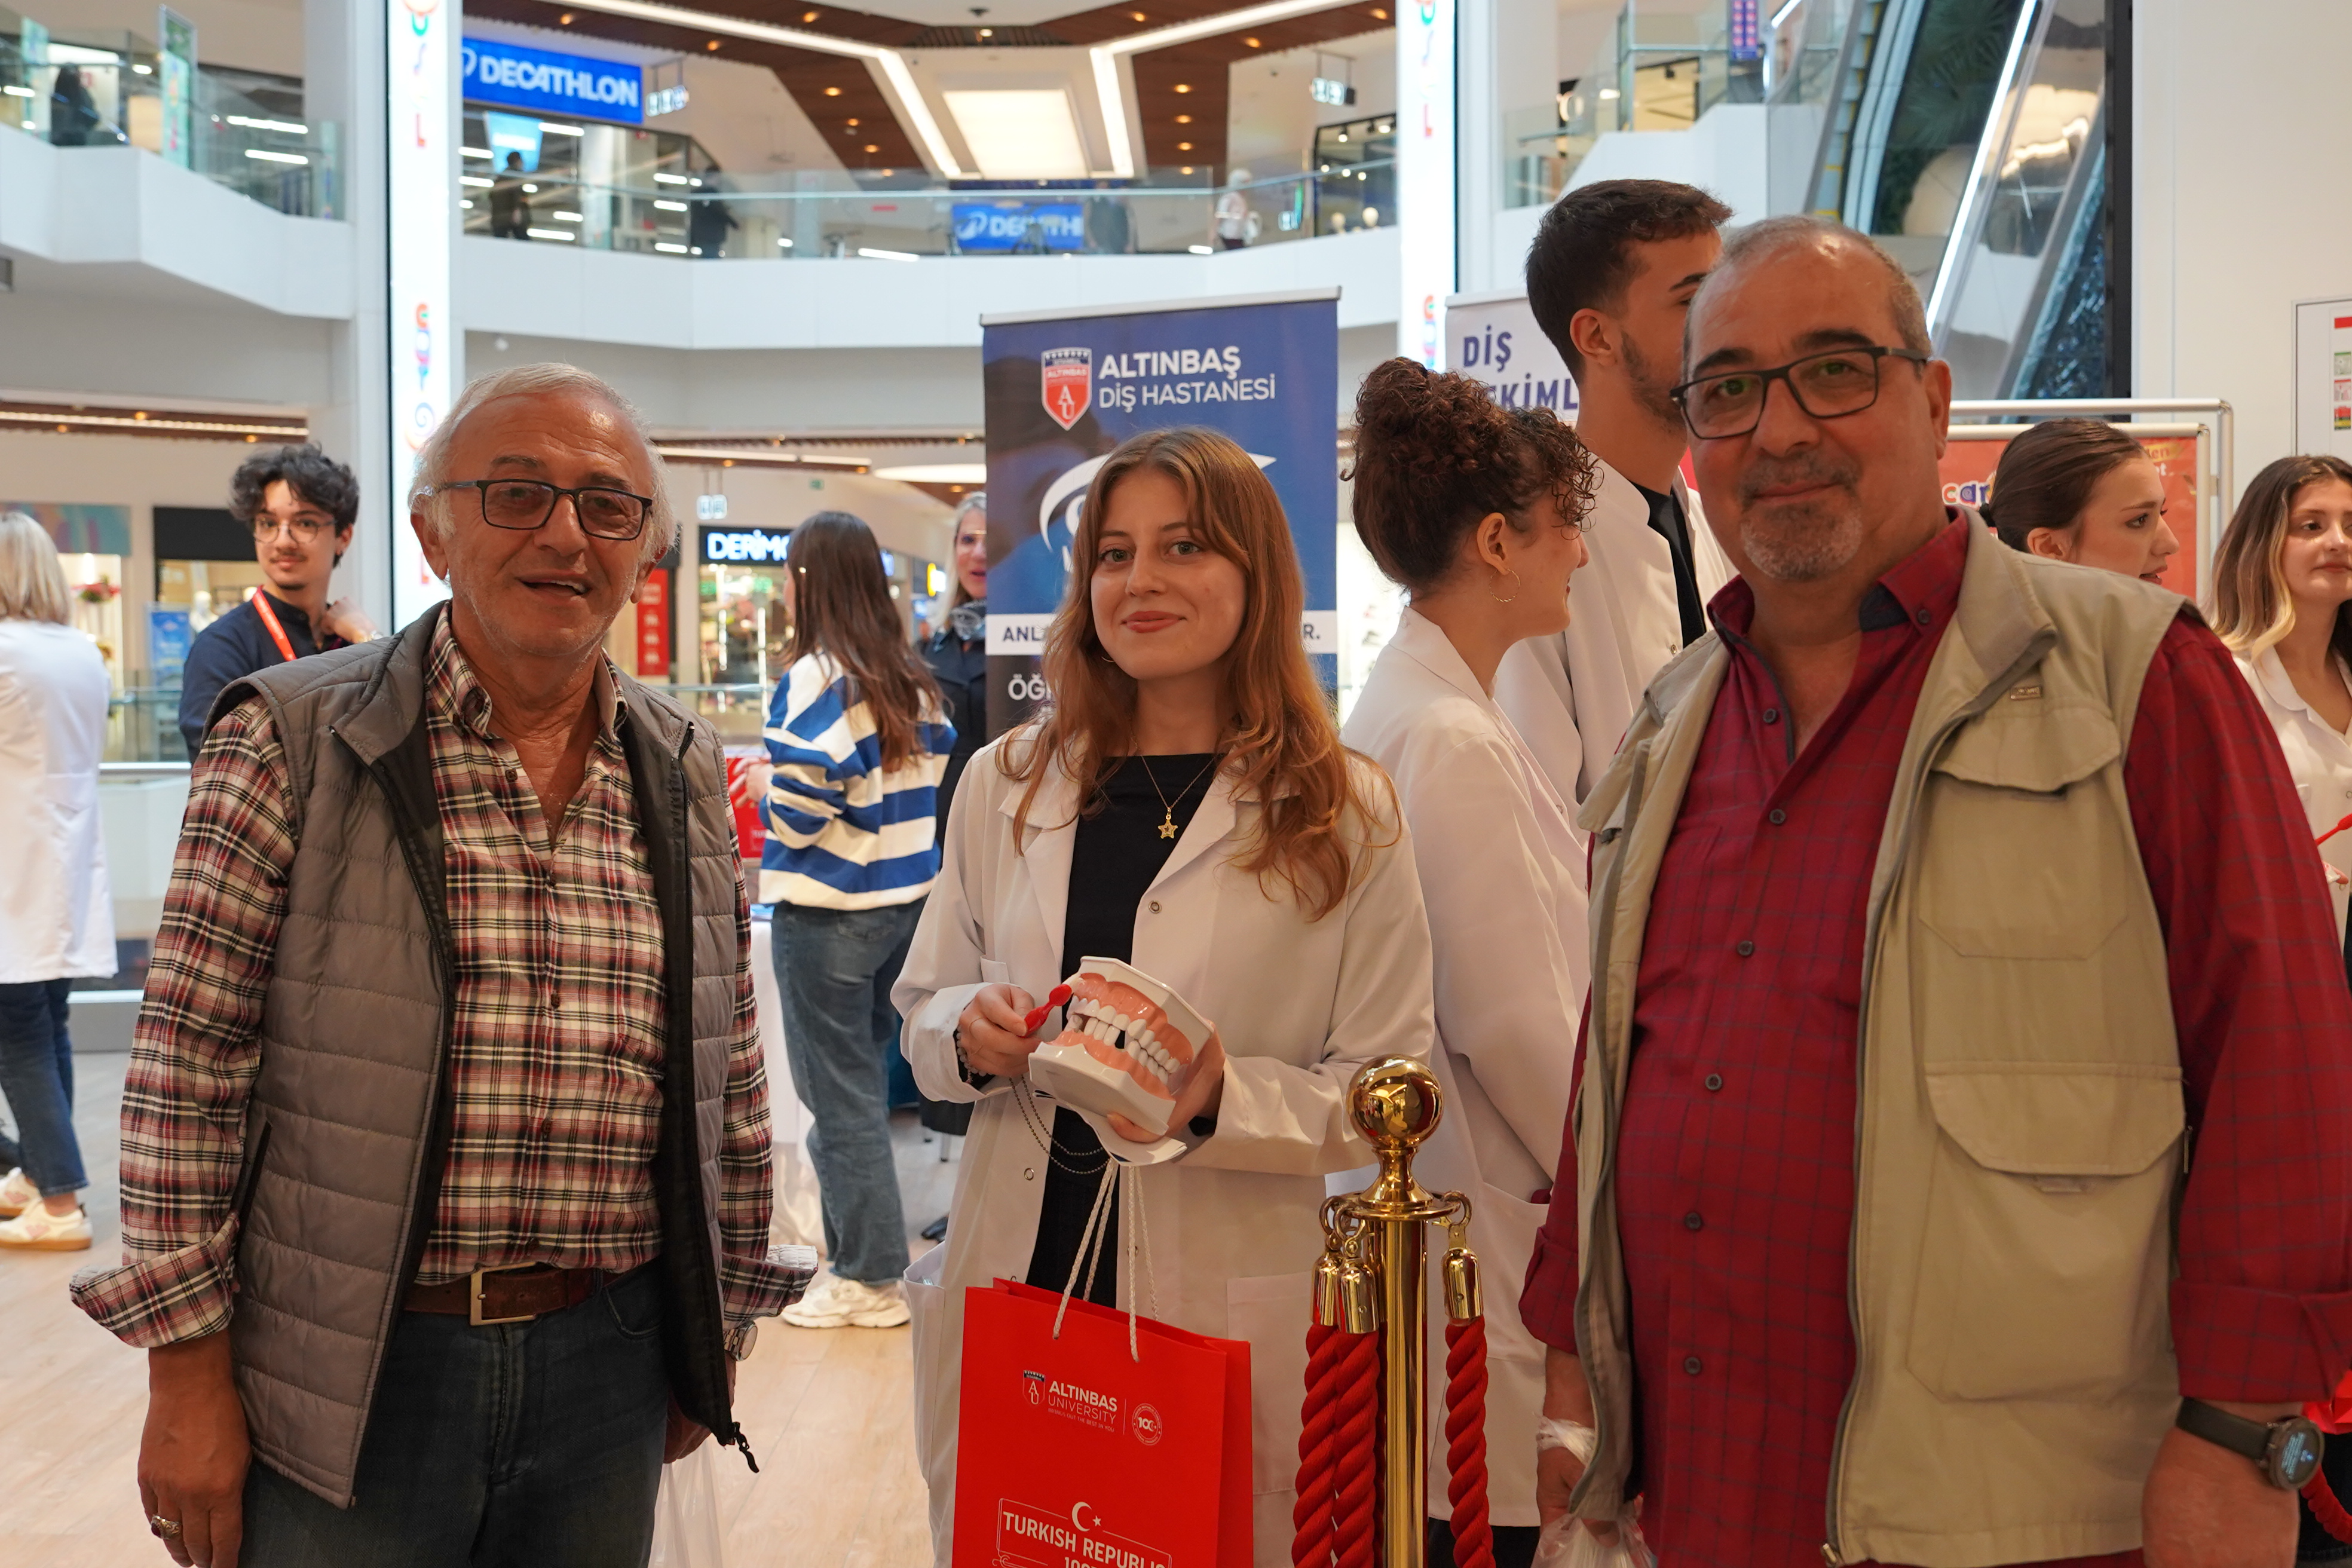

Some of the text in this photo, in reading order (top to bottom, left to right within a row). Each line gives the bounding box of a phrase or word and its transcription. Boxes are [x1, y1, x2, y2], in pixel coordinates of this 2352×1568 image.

[480, 55, 639, 108] DECATHLON
[1098, 345, 1242, 380] ALTINBAŞ
[1463, 324, 1512, 372] DİŞ
[1099, 373, 1276, 413] DİŞ HASTANESİ
[1488, 372, 1578, 411] KİML
[1048, 1394, 1116, 1425] UNIVERSITY
[1003, 1511, 1165, 1568] TURKISH REPUBL
